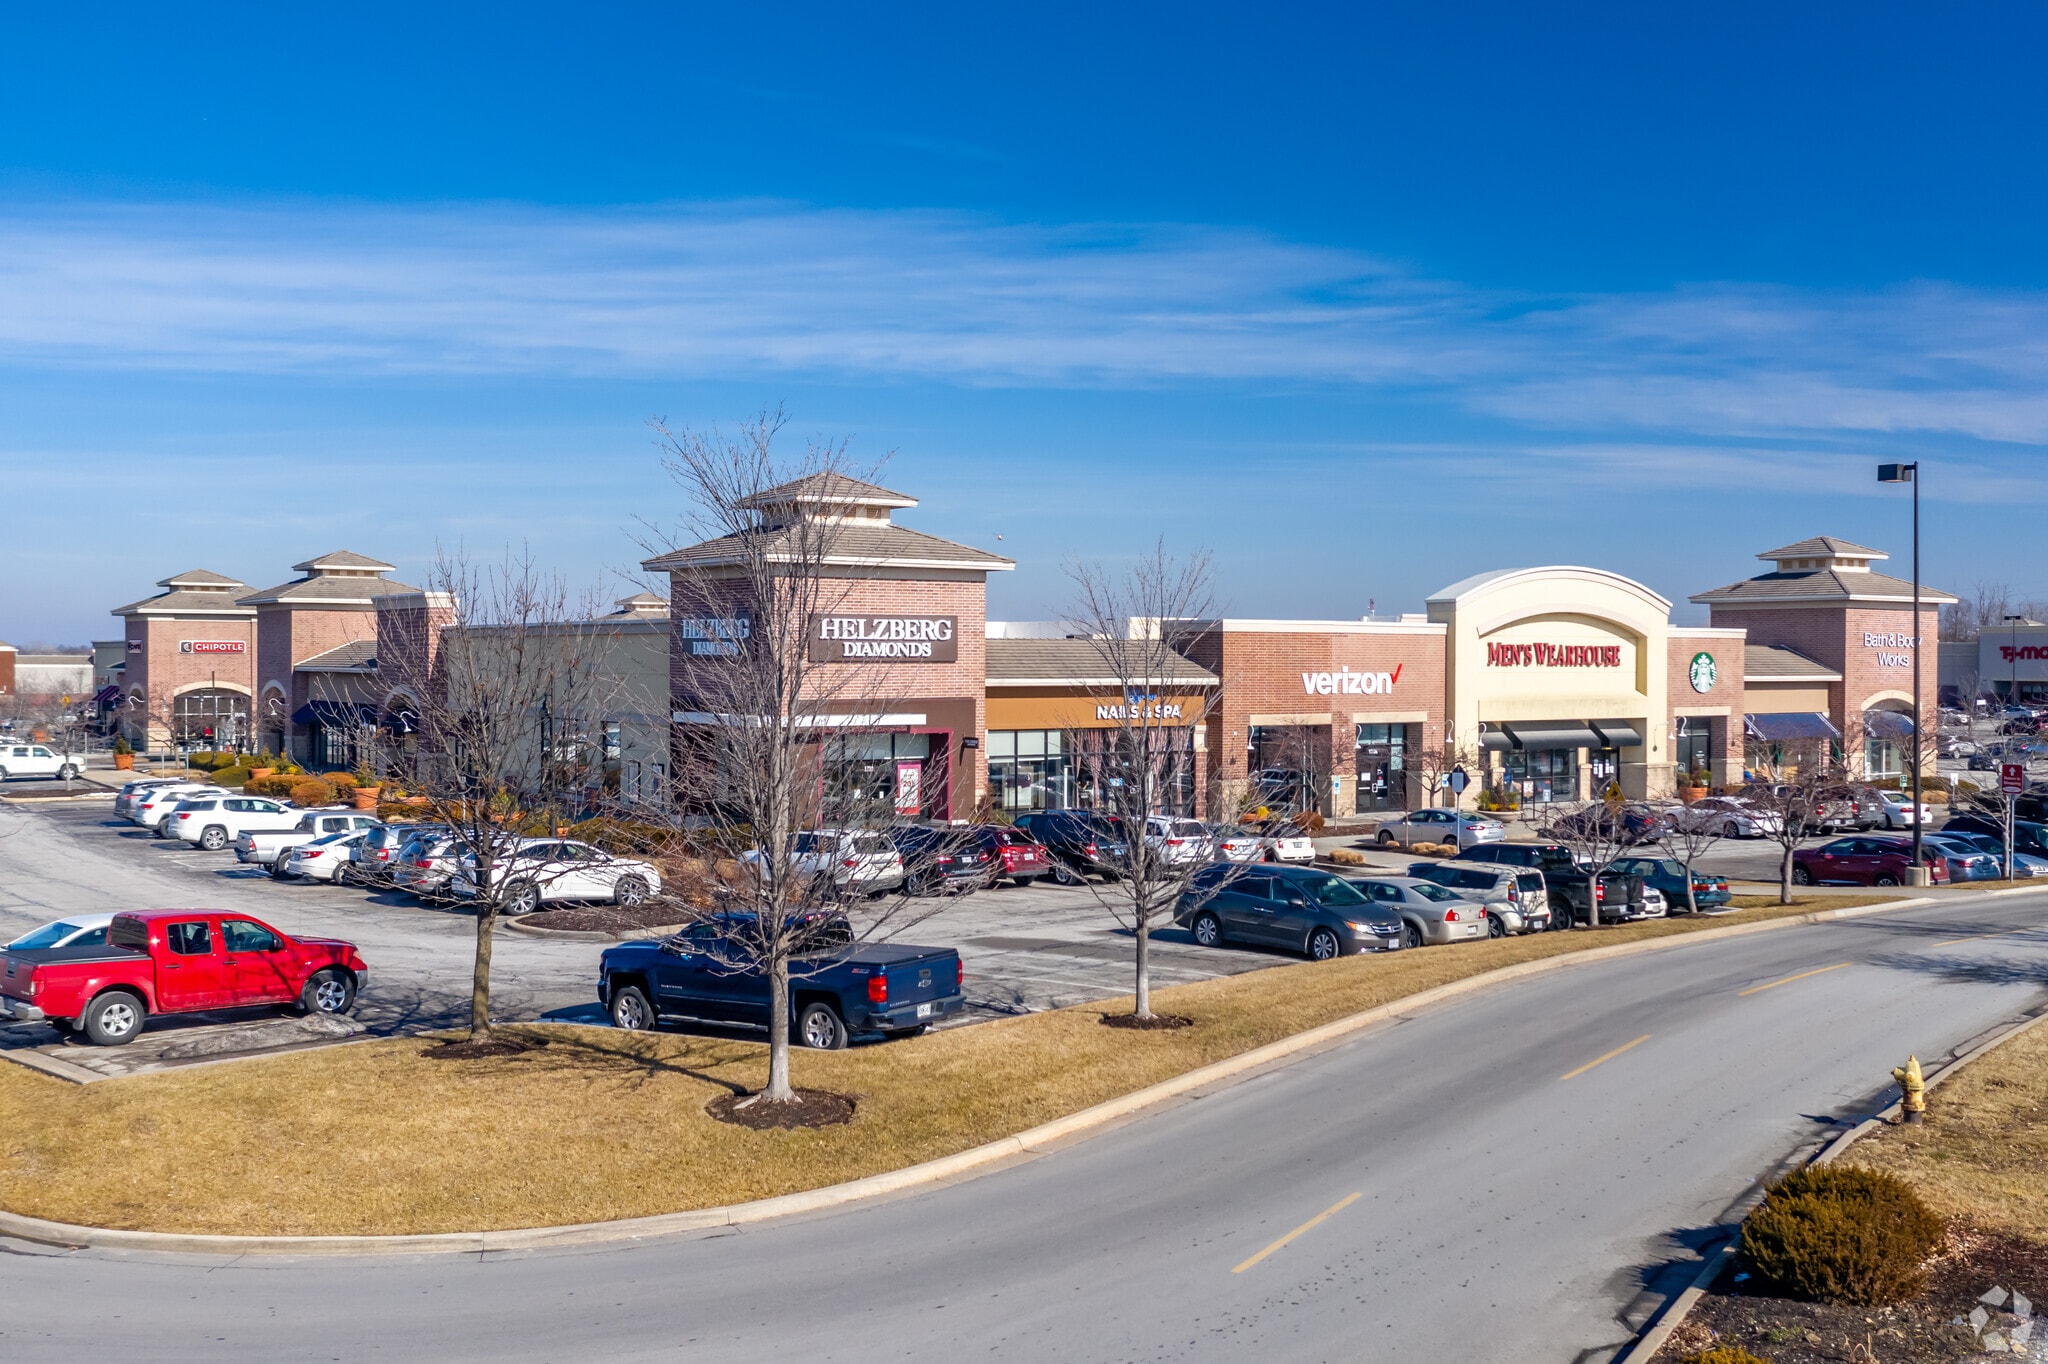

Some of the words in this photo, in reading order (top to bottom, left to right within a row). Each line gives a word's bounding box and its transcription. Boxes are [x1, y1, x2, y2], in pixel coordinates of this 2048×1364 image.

[819, 618, 952, 641] HELZBERG
[195, 643, 244, 651] CHIPOTLE
[1863, 632, 1888, 647] Bath
[1888, 633, 1896, 647] &
[842, 641, 932, 657] DIAMONDS
[1487, 642, 1532, 667] MEN'S
[1533, 642, 1620, 667] WEARHOUSE
[1877, 651, 1909, 667] Works
[1301, 665, 1392, 695] verizon
[1142, 706, 1153, 719] &
[1154, 704, 1182, 719] SPA
